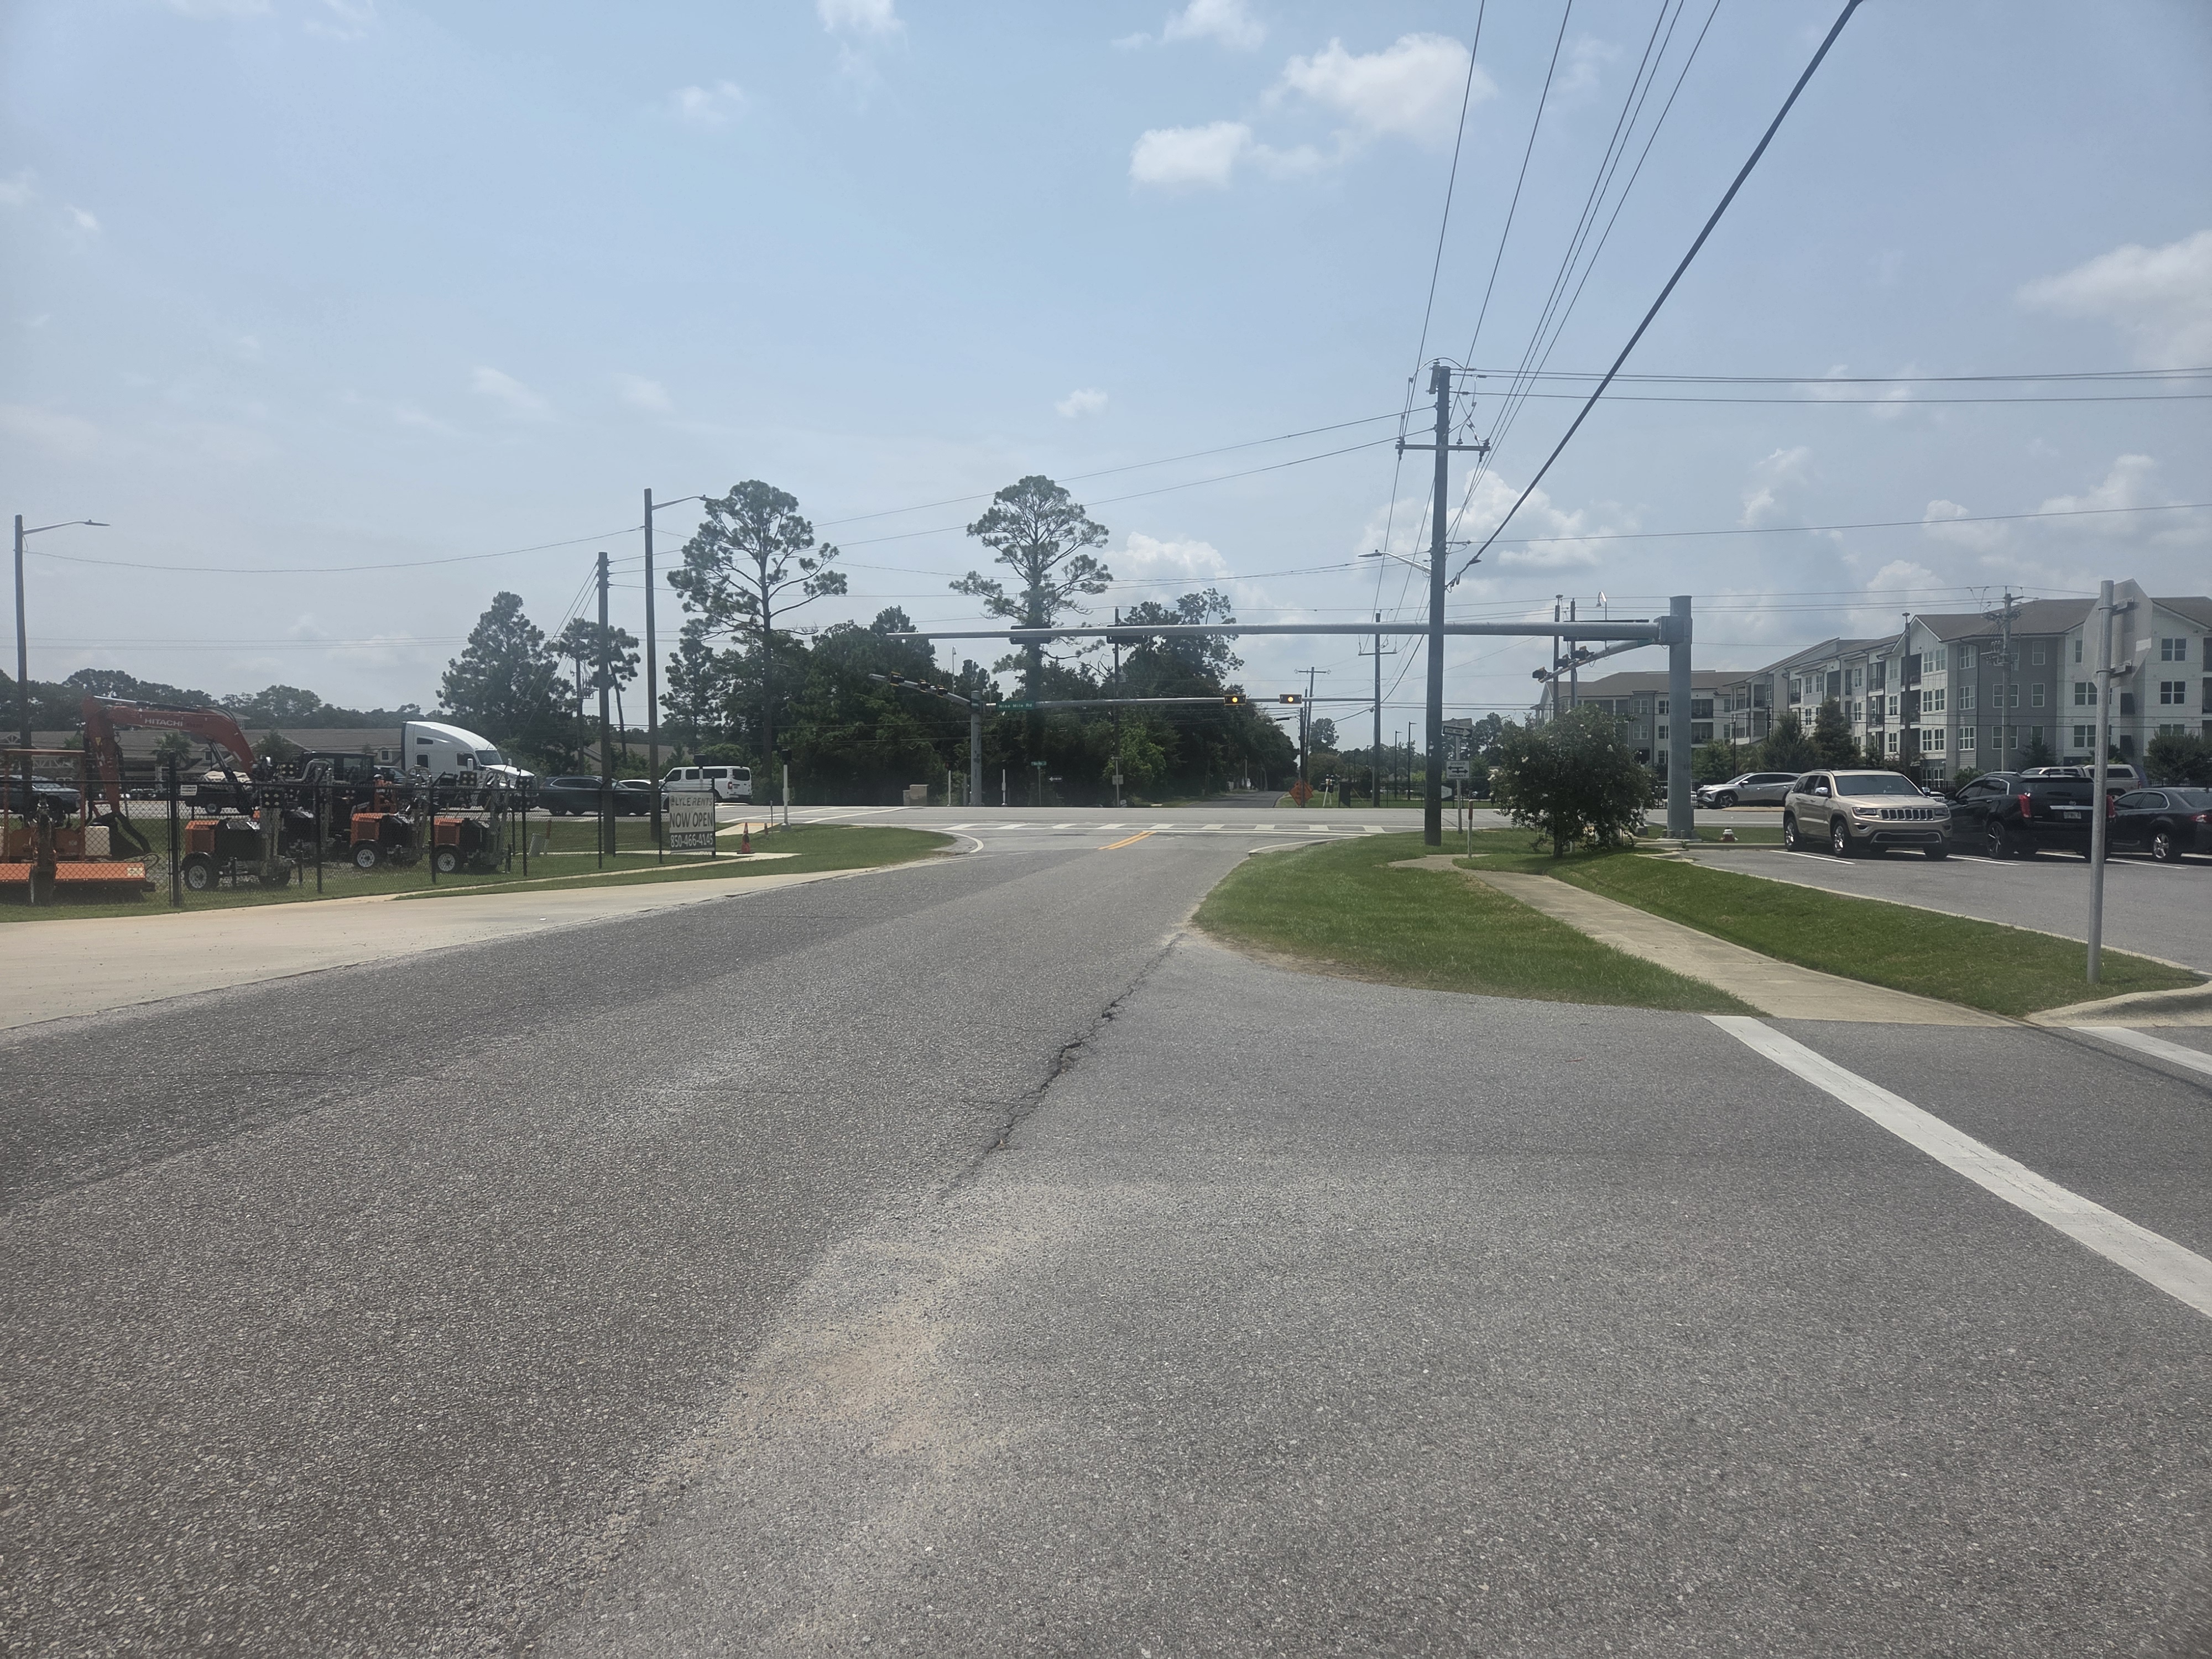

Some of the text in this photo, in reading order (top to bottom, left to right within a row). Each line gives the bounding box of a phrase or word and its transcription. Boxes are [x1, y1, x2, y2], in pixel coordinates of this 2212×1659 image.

[144, 718, 183, 727] HITACHI
[675, 797, 713, 806] LYLE RENTS
[670, 812, 713, 828] NOW OPEN
[671, 833, 713, 847] 850-466-4145
